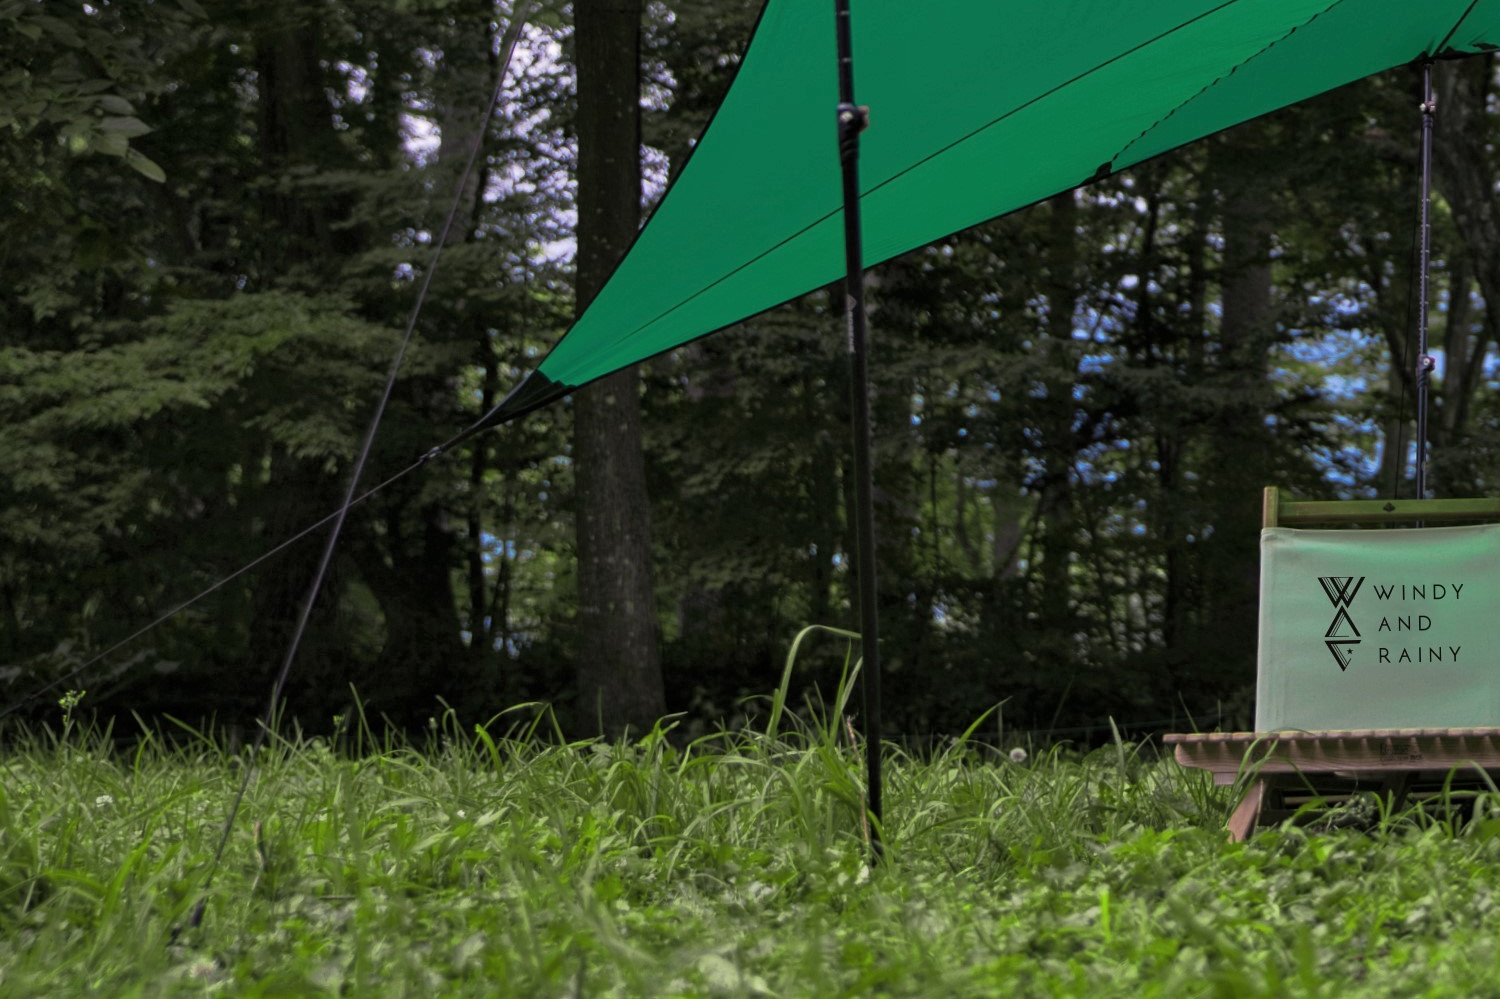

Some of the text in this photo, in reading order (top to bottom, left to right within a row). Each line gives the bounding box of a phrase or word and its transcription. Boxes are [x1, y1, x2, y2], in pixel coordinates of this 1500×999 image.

[1373, 583, 1464, 601] WINDY
[1378, 615, 1432, 632] AND
[1379, 646, 1461, 664] RAINY
